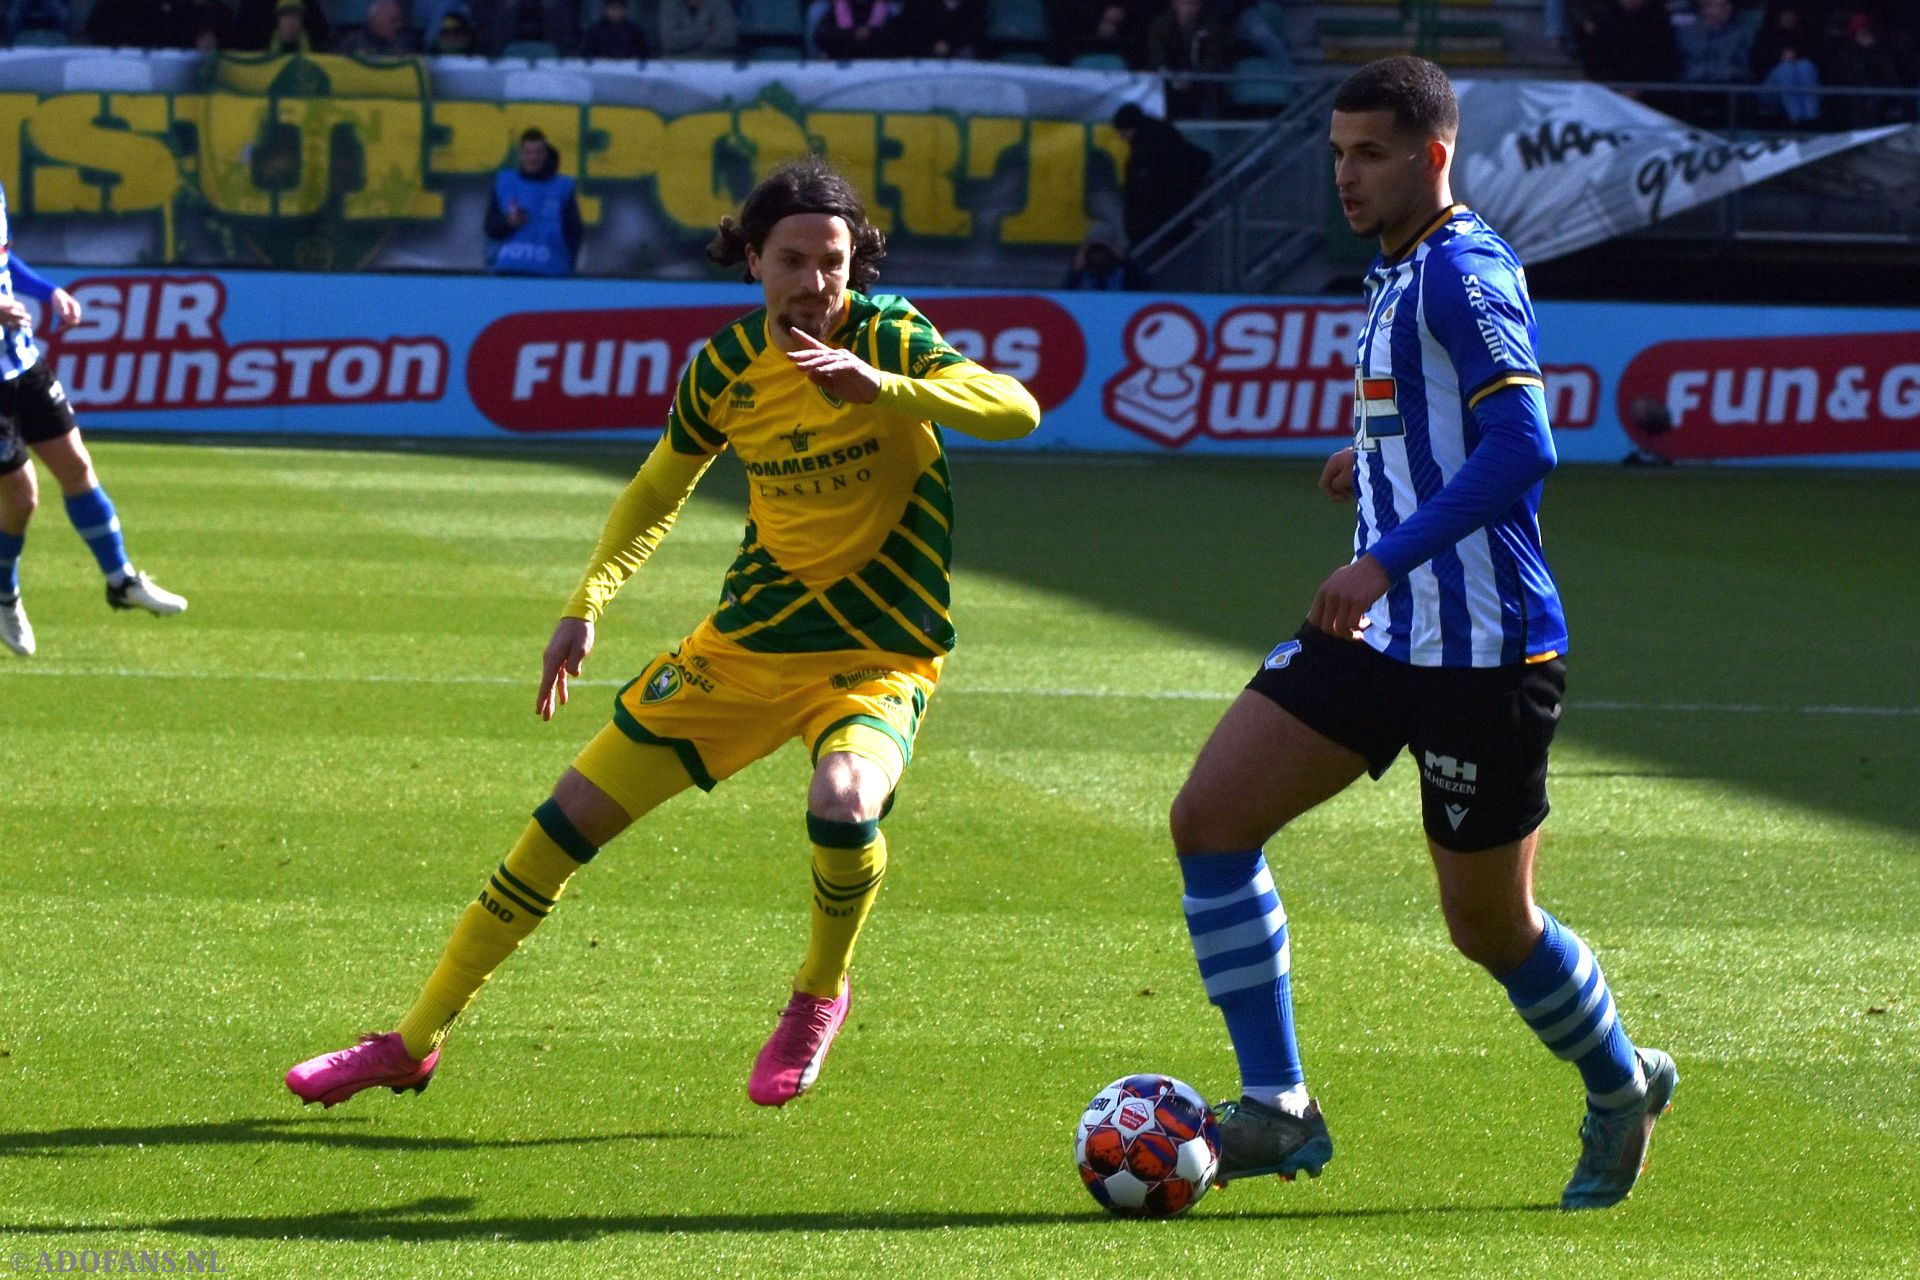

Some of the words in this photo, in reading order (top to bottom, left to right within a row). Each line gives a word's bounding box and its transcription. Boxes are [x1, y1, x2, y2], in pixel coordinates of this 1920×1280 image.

[60, 281, 219, 342] SIR
[1461, 273, 1487, 313] SRP
[1216, 310, 1368, 371] SIR
[1424, 768, 1476, 795] M.HEEZEN
[478, 889, 514, 923] ADO
